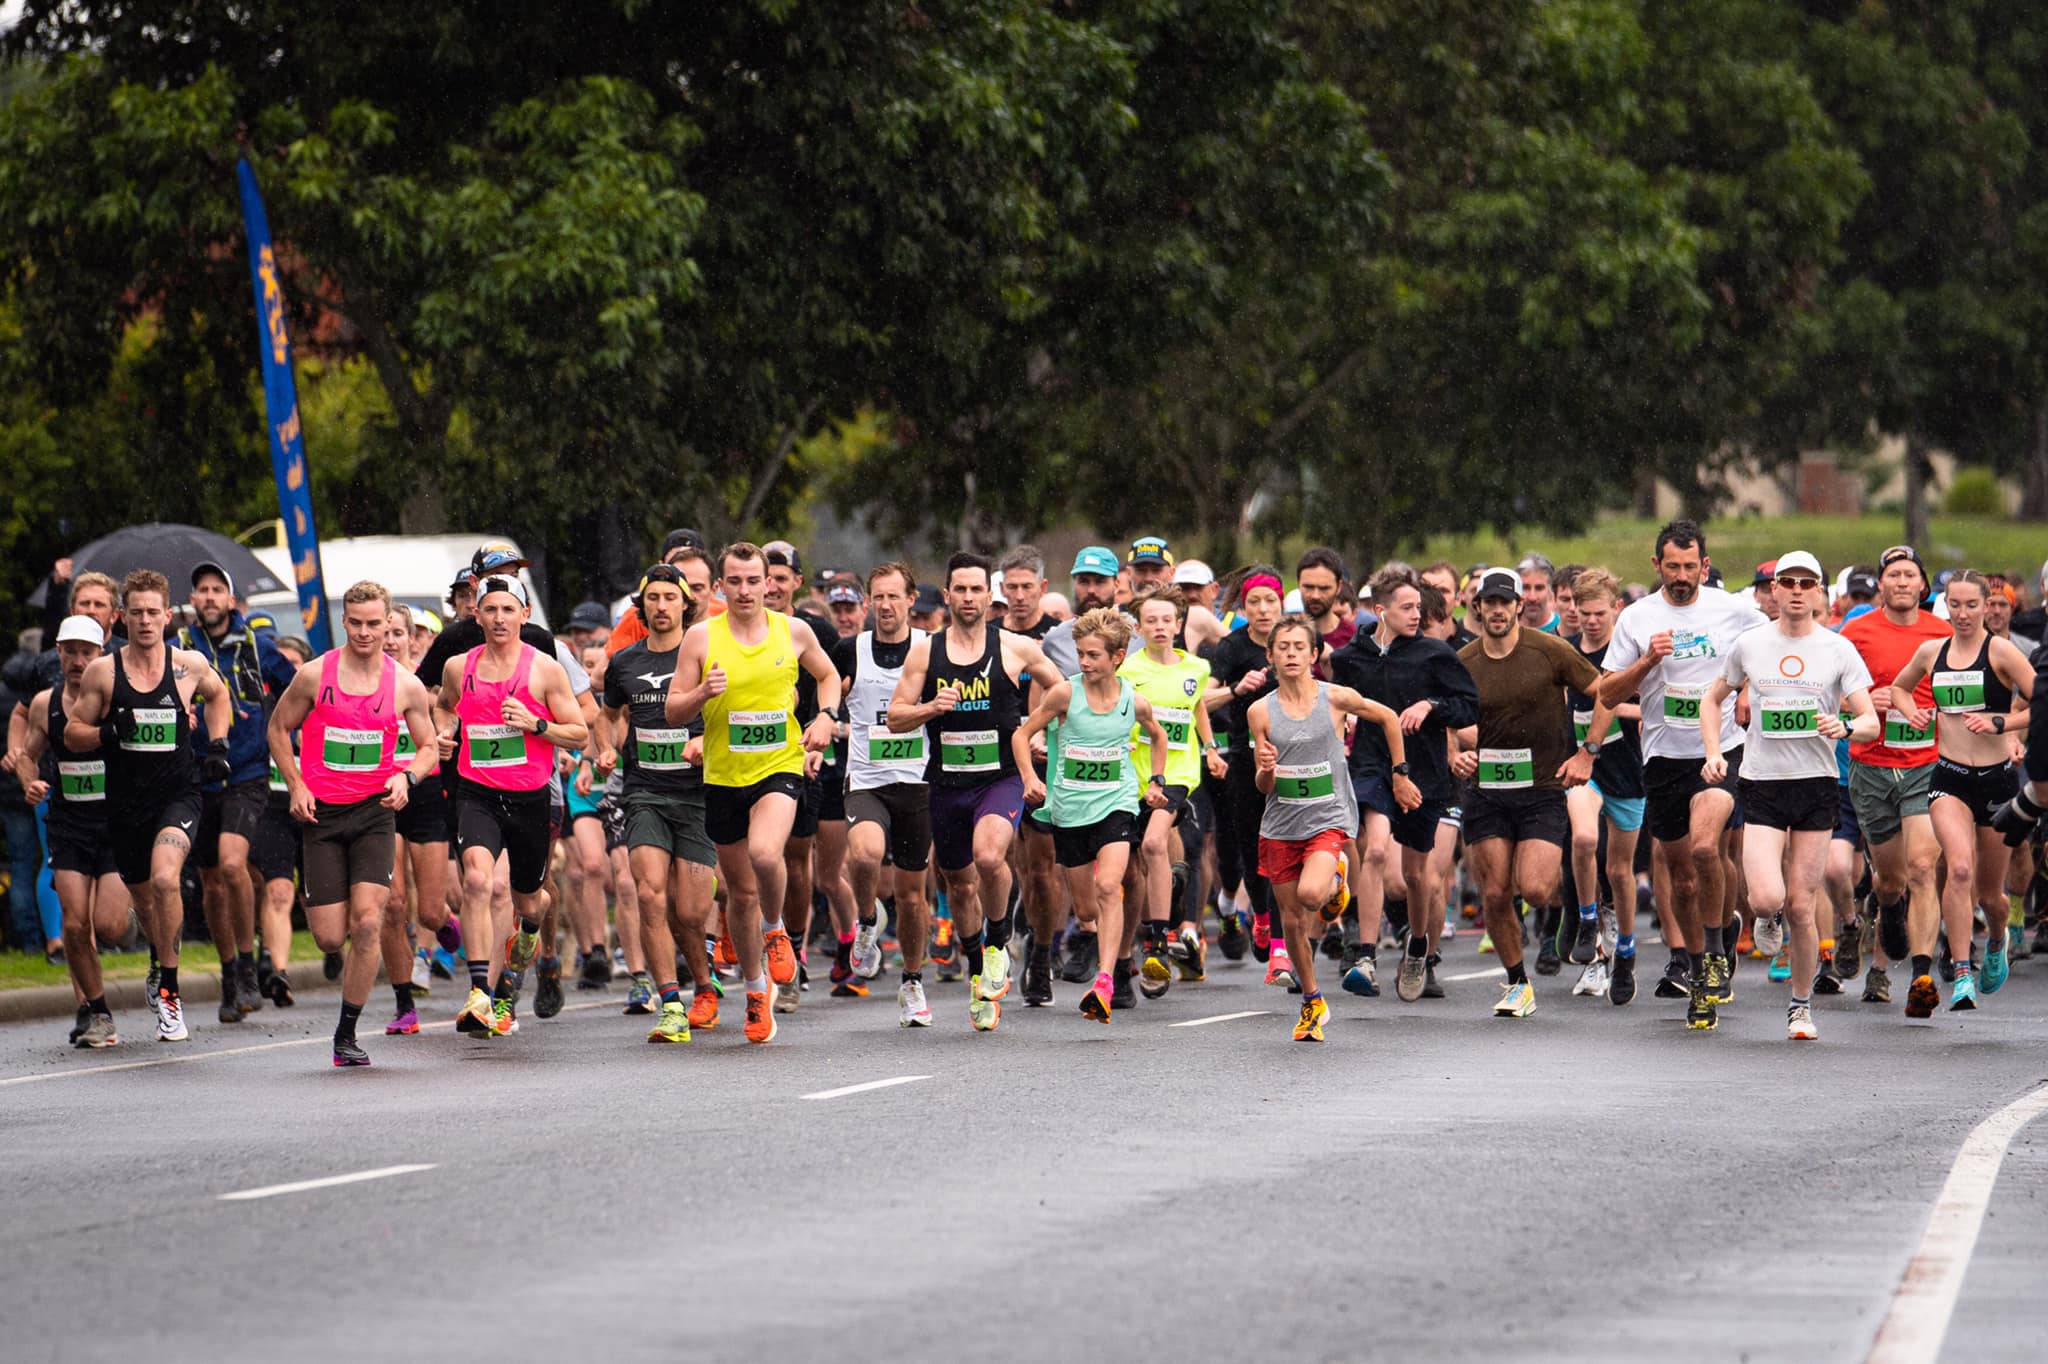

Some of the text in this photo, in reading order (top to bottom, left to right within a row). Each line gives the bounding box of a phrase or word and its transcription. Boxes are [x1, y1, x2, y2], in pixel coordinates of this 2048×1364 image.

[1758, 678, 1824, 688] OSTEOHEALTH
[1947, 687, 1965, 705] 10
[953, 699, 991, 712] AGUE
[1675, 699, 1701, 717] 29
[1771, 711, 1808, 731] 360
[131, 725, 165, 743] 208
[741, 725, 777, 745] 298
[1159, 722, 1183, 741] 28
[348, 745, 355, 763] 1
[490, 741, 501, 759] 2
[648, 743, 677, 762] 371
[882, 740, 914, 758] 227
[964, 746, 976, 764] 3
[1075, 762, 1110, 781] 225
[1494, 763, 1517, 782] 56
[1946, 763, 1969, 775] PRO
[74, 776, 95, 794] 74
[1297, 780, 1310, 797] 5
